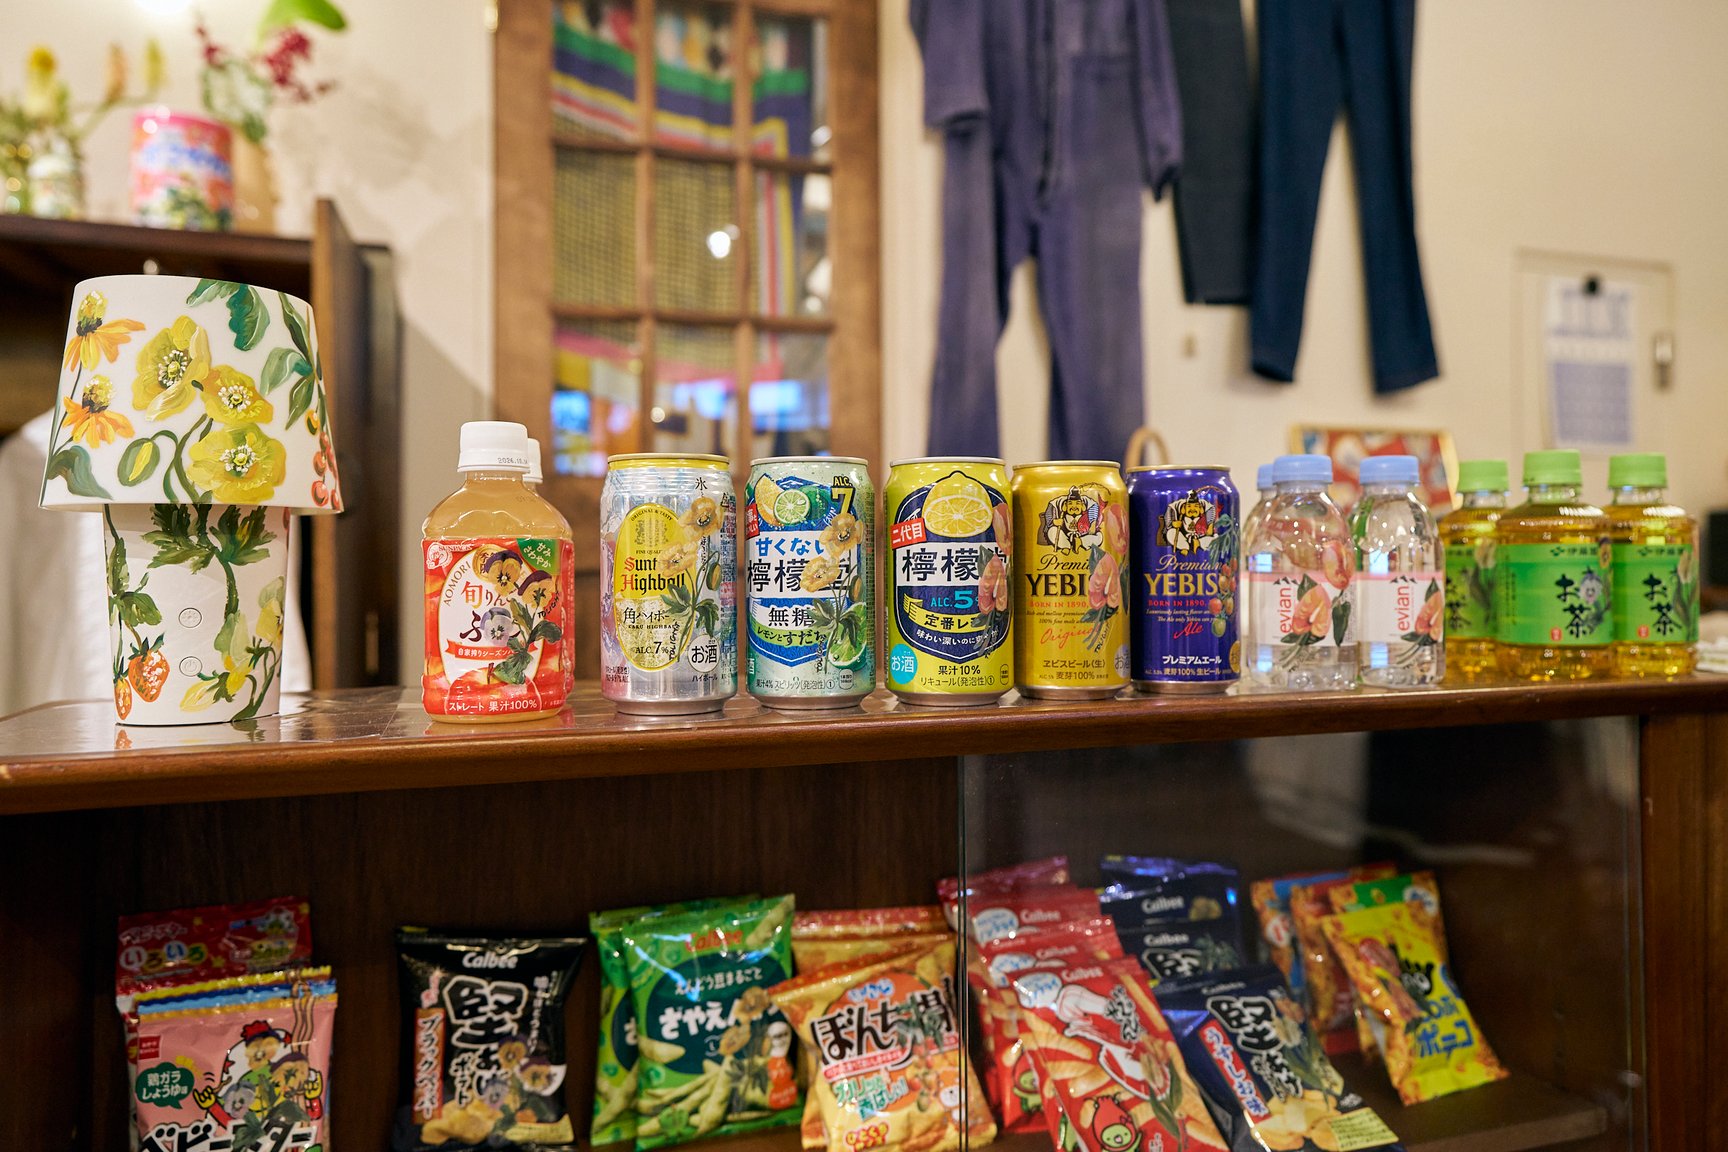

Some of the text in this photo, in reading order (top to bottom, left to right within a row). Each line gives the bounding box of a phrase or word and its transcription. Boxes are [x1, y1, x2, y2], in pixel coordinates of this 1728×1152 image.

[833, 476, 853, 487] ALC.
[892, 522, 923, 545] 二代目
[624, 556, 657, 572] Sunt
[1037, 554, 1090, 571] Premi
[443, 560, 471, 607] AOMORI
[1025, 573, 1091, 597] YEBI
[1144, 573, 1219, 597] YEBIS
[1029, 600, 1051, 608] BORN
[1148, 599, 1171, 607] BORN
[1277, 587, 1292, 634] evian
[1394, 585, 1410, 632] evian
[623, 606, 670, 625] 角ハイボー
[768, 607, 816, 627] 無糖
[924, 613, 973, 631] 定番レ
[1173, 621, 1204, 640] Ale
[691, 644, 718, 664] お酒
[1162, 655, 1222, 665] プレミアムエール
[891, 655, 914, 673] お酒
[938, 665, 980, 675] 果汁10%
[1056, 671, 1095, 680] 麦芽100%
[449, 702, 485, 712] ストレート
[489, 700, 537, 712] 果汁100%
[462, 952, 518, 969] Calbee
[414, 1016, 441, 1120] ブラックペッパー
